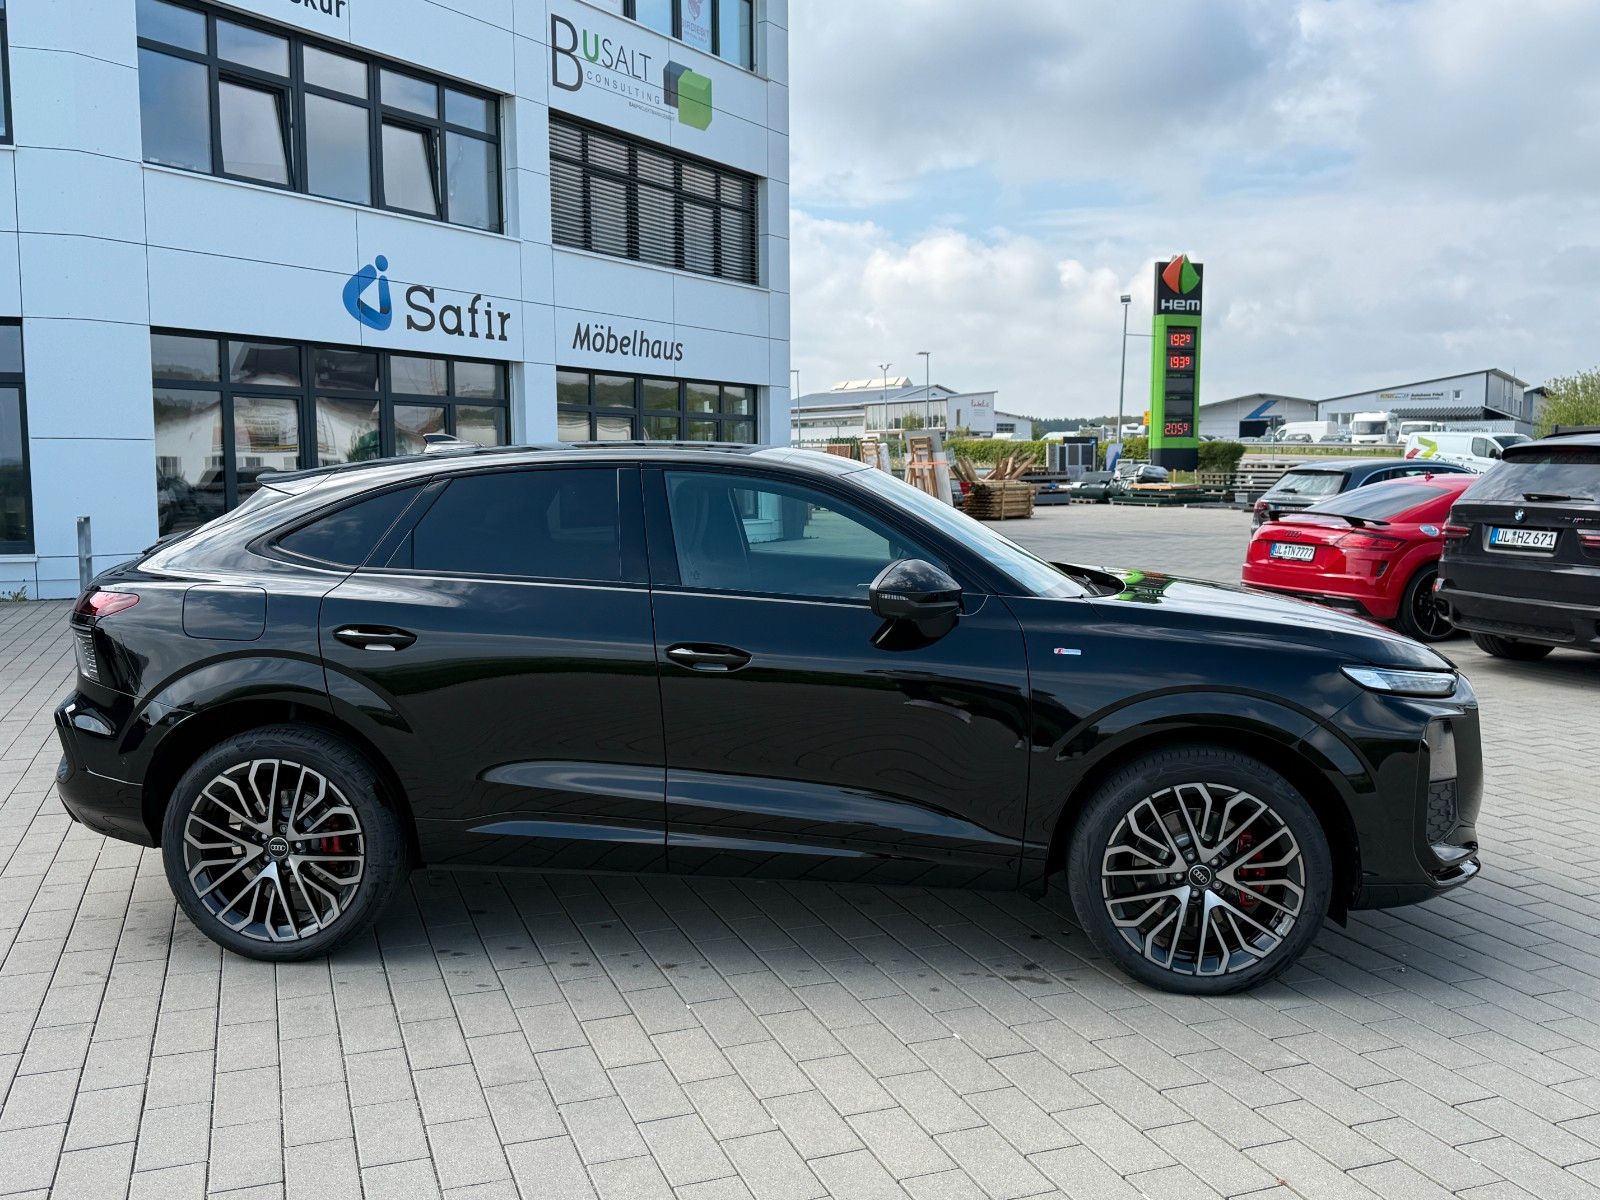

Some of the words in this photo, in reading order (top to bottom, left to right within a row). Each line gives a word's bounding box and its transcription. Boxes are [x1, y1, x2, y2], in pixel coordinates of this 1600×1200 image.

[290, 0, 347, 18] ur
[551, 13, 652, 92] BUSALT
[586, 70, 660, 105] CONSULTING
[405, 285, 511, 341] Safir
[572, 322, 684, 362] Möbelhaus
[1496, 527, 1510, 543] UL
[1516, 531, 1532, 545] HZ
[1532, 533, 1554, 546] 671
